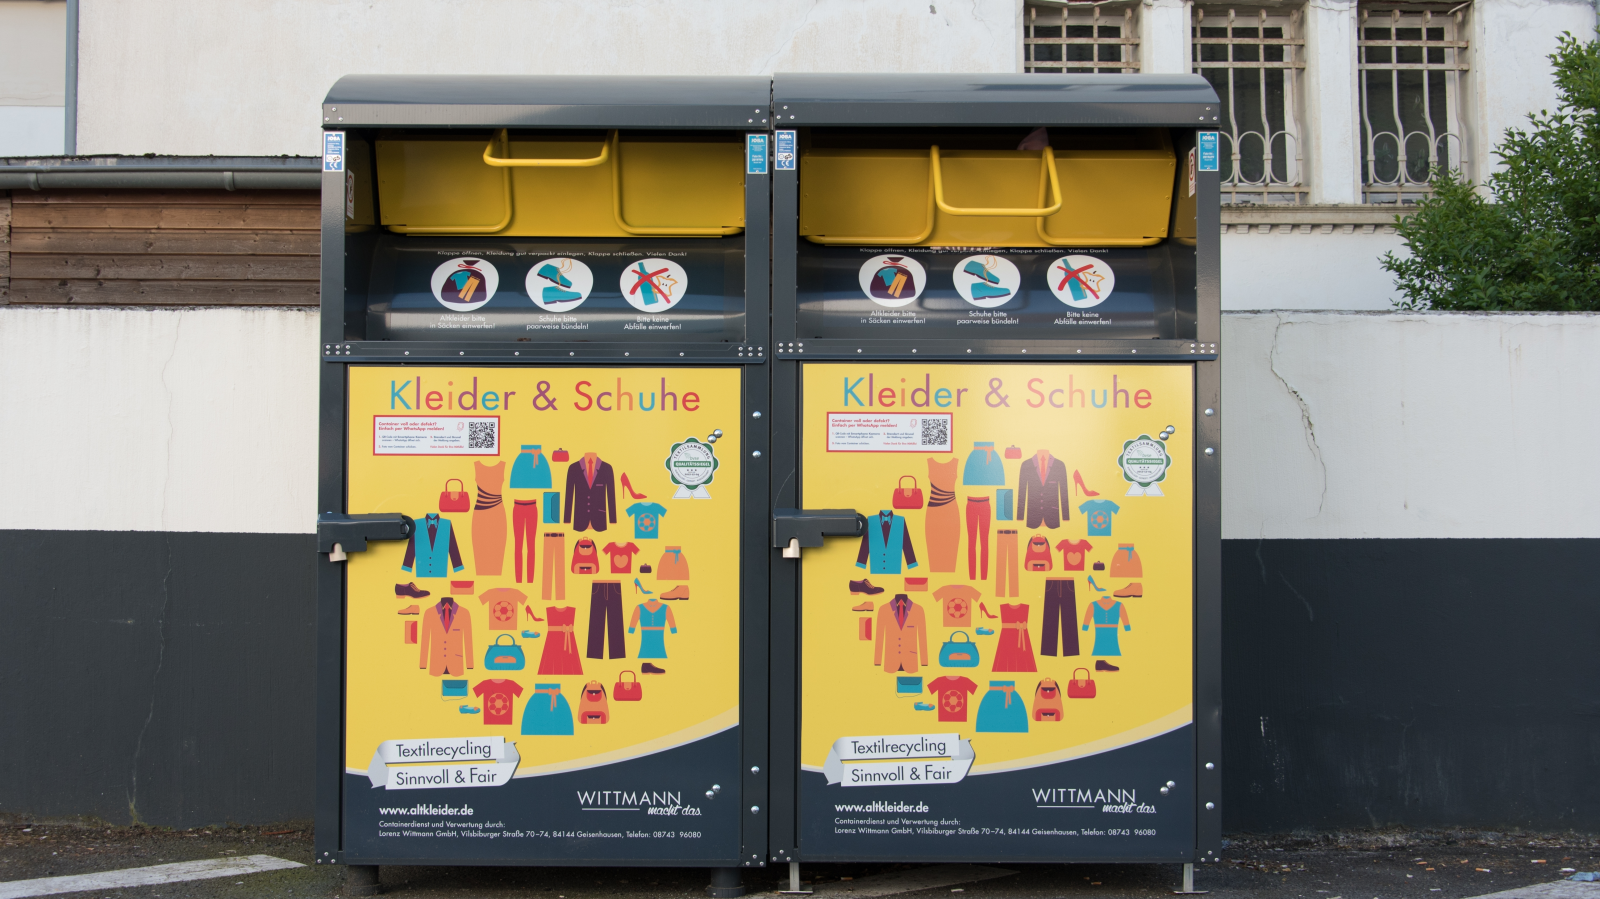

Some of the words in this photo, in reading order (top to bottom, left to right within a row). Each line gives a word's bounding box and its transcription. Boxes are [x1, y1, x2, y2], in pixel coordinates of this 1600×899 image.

[390, 376, 516, 411] Kleider
[532, 380, 558, 411] &
[574, 377, 700, 412] Schuhe
[843, 372, 968, 407] Kleider
[984, 377, 1010, 408] &
[1026, 374, 1152, 409] Schuhe
[674, 444, 710, 459] TEXTILSAMMLUNG
[1126, 442, 1163, 456] TEXTILSAMMLUNG
[396, 740, 491, 759] Textilrecycling
[851, 737, 946, 756] Textilrecycling
[396, 769, 449, 785] Sinnvoll
[454, 770, 466, 783] &
[470, 767, 497, 783] Fair
[851, 766, 904, 782] Sinnvoll
[910, 767, 920, 780] &
[925, 765, 952, 780] Fair
[577, 790, 681, 805] WITTMANN
[1032, 788, 1135, 803] WITTMANN
[379, 804, 474, 816] www.altkleider.de
[648, 804, 682, 816] macht
[682, 805, 702, 816] das.
[835, 801, 929, 813] www.altkleider.de
[1102, 802, 1137, 814] macht
[1136, 802, 1157, 813] das.
[901, 818, 938, 826] Verwertung
[461, 830, 500, 839] Vilsbiburger
[916, 828, 956, 836] Vilsbiburger
[1032, 828, 1079, 836] Geisenhausen,
